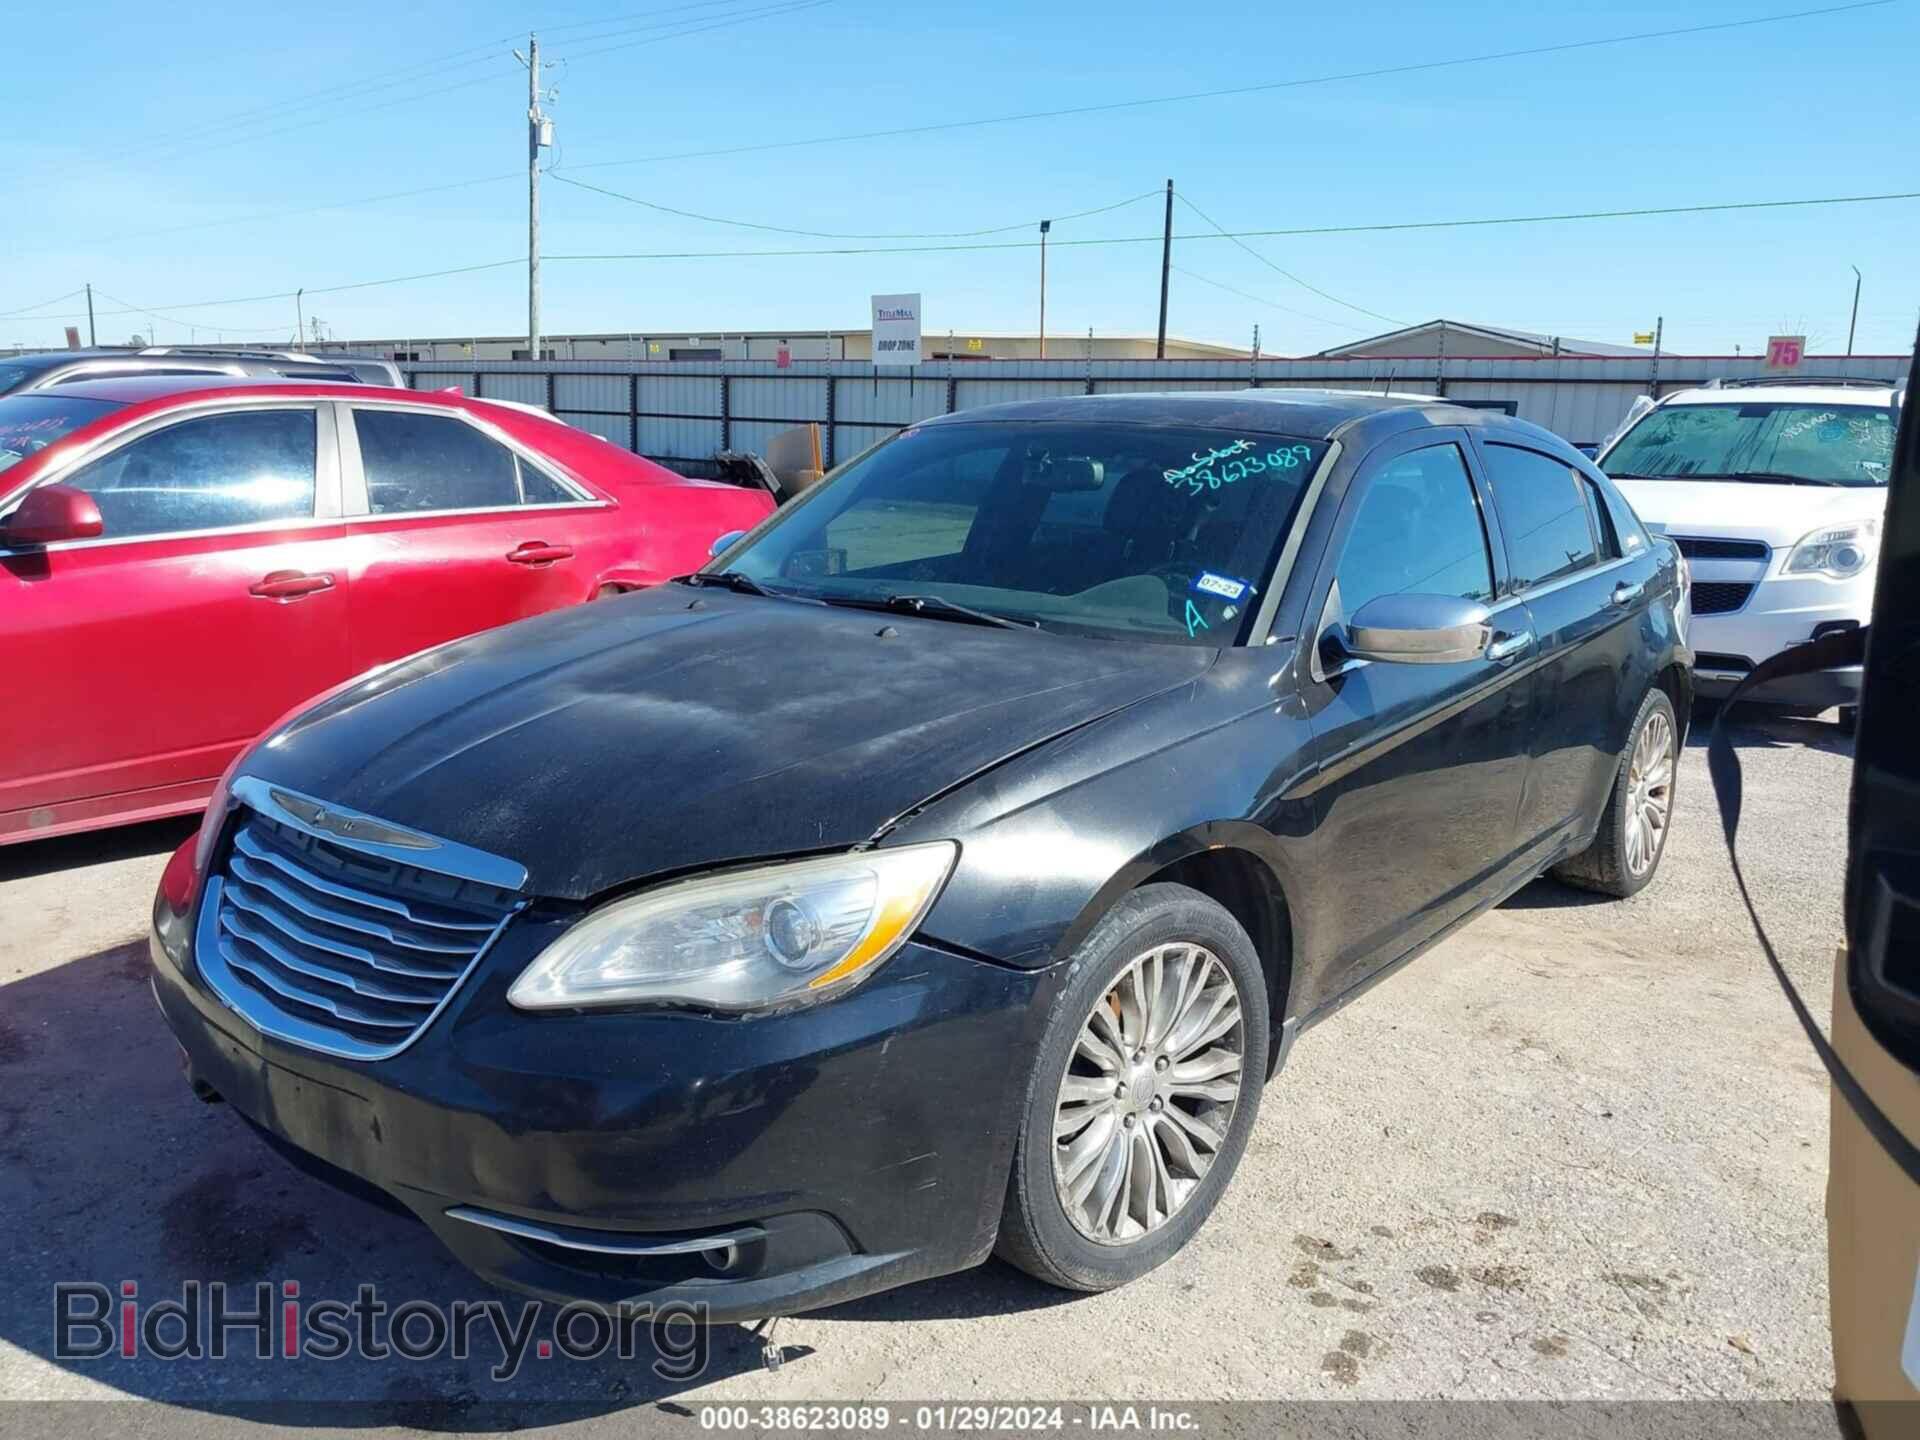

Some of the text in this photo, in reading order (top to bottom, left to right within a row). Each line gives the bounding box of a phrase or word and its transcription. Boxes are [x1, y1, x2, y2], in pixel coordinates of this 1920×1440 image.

[878, 340, 915, 351] DROP ZONE
[1771, 342, 1799, 368] 75
[1185, 599, 1209, 638] A
